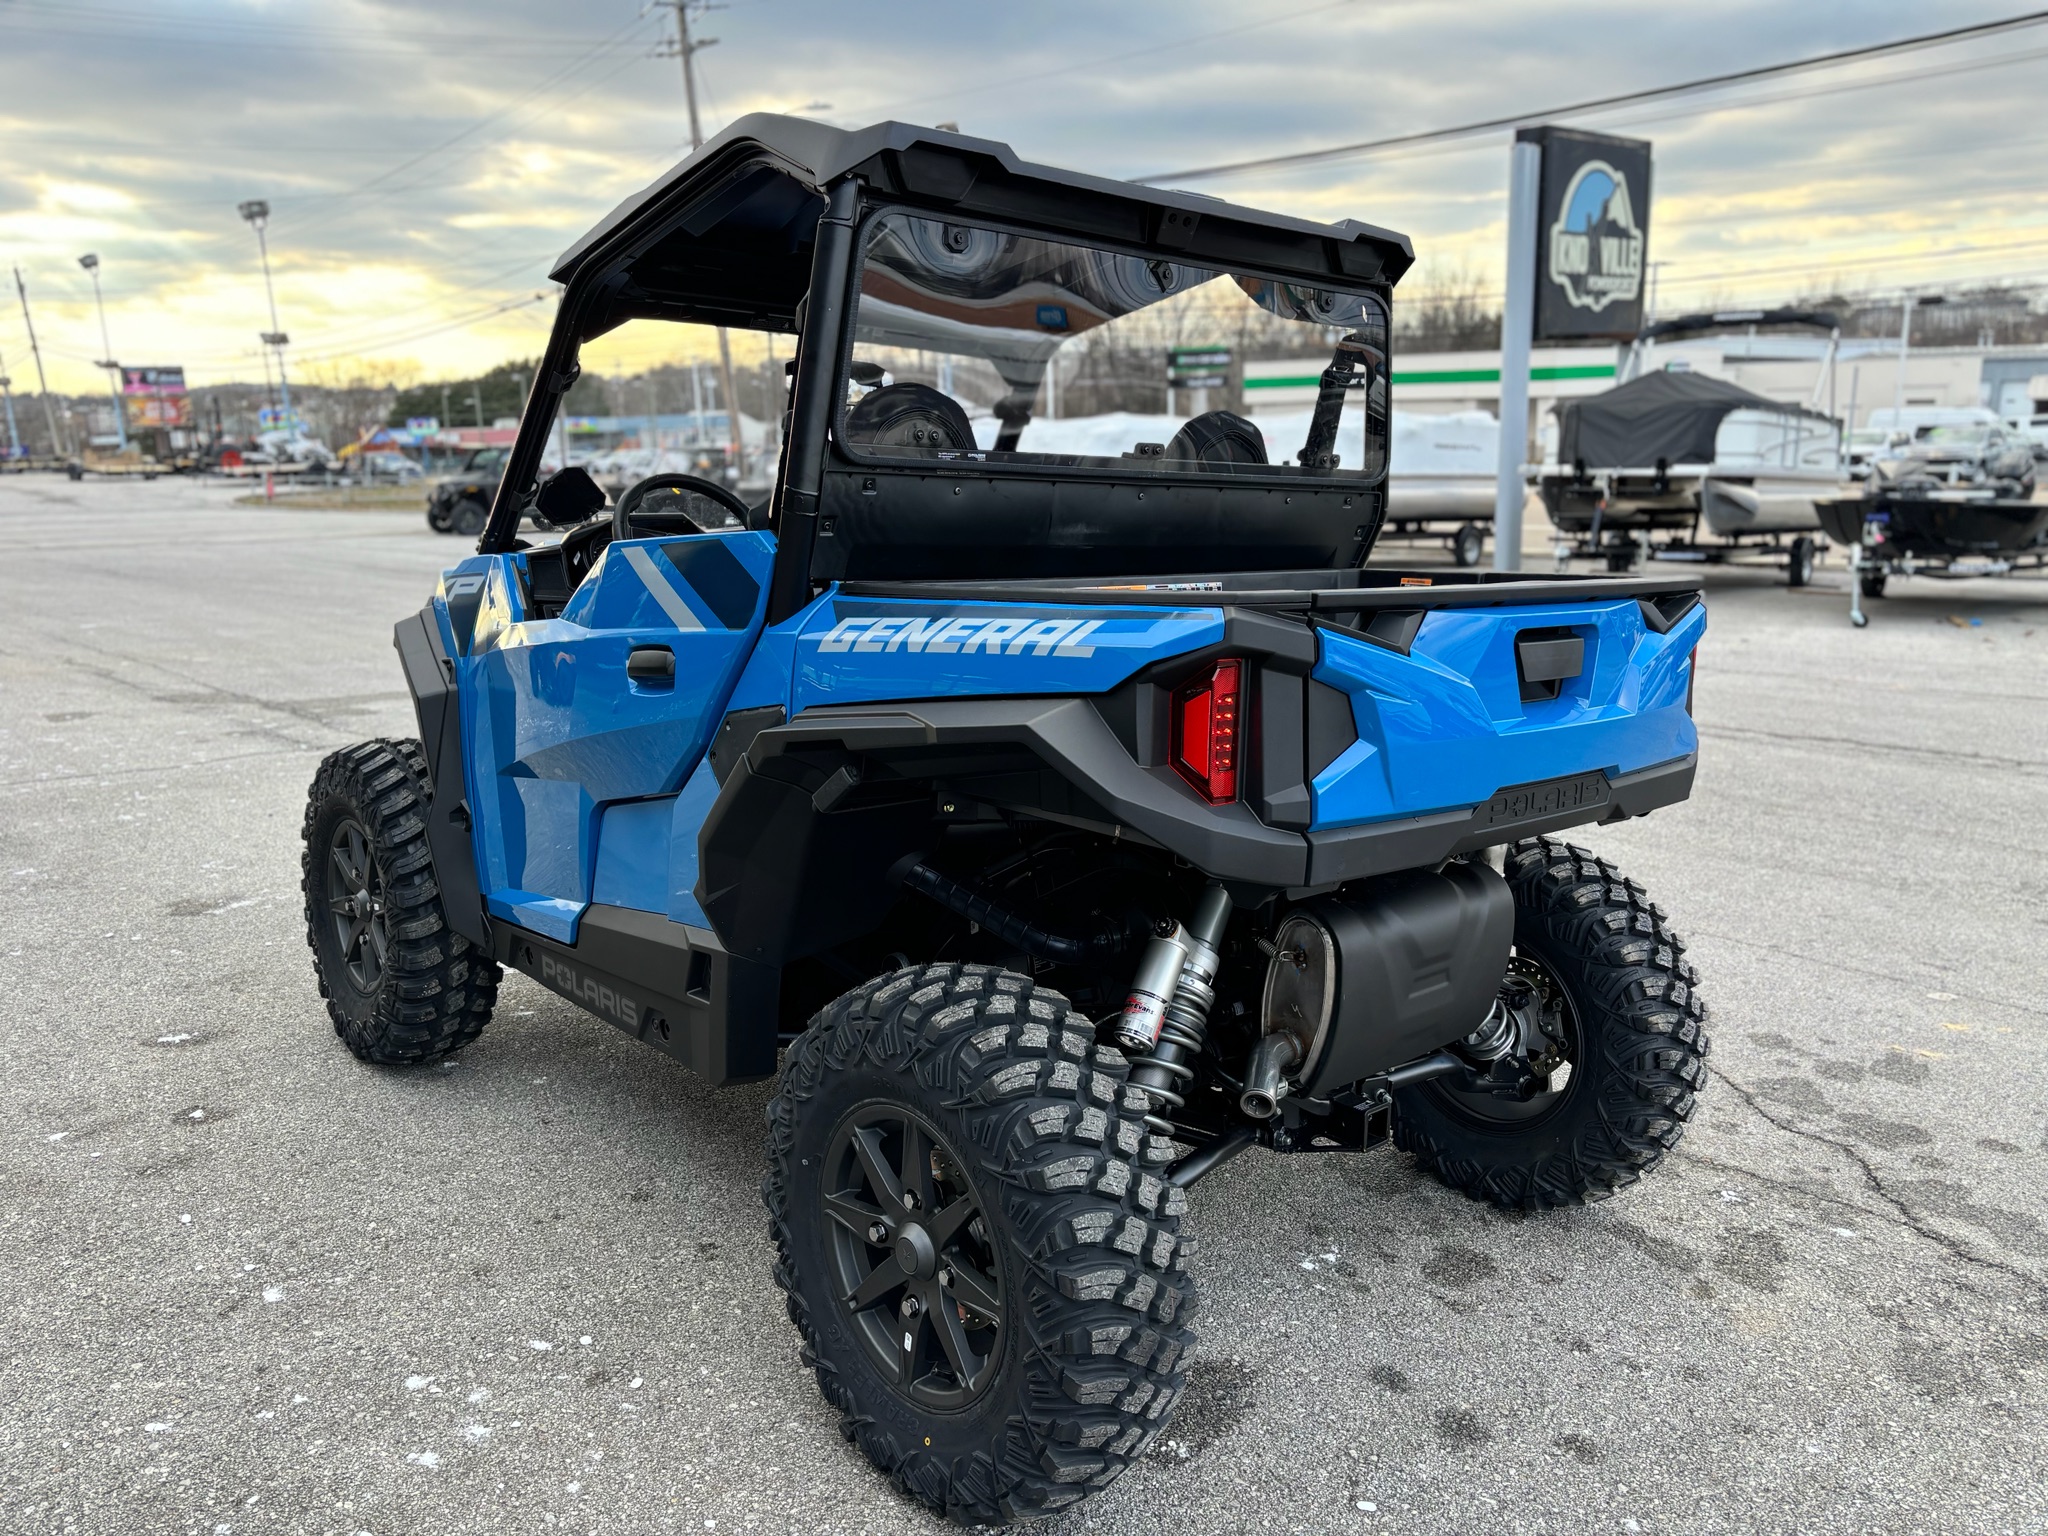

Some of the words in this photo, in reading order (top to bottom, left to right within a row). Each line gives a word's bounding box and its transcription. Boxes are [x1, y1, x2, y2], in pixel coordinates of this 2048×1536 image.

[445, 575, 486, 603] P
[817, 616, 1107, 659] GENERAL
[1488, 778, 1601, 824] POLARIS
[541, 954, 639, 1027] POLARIS
